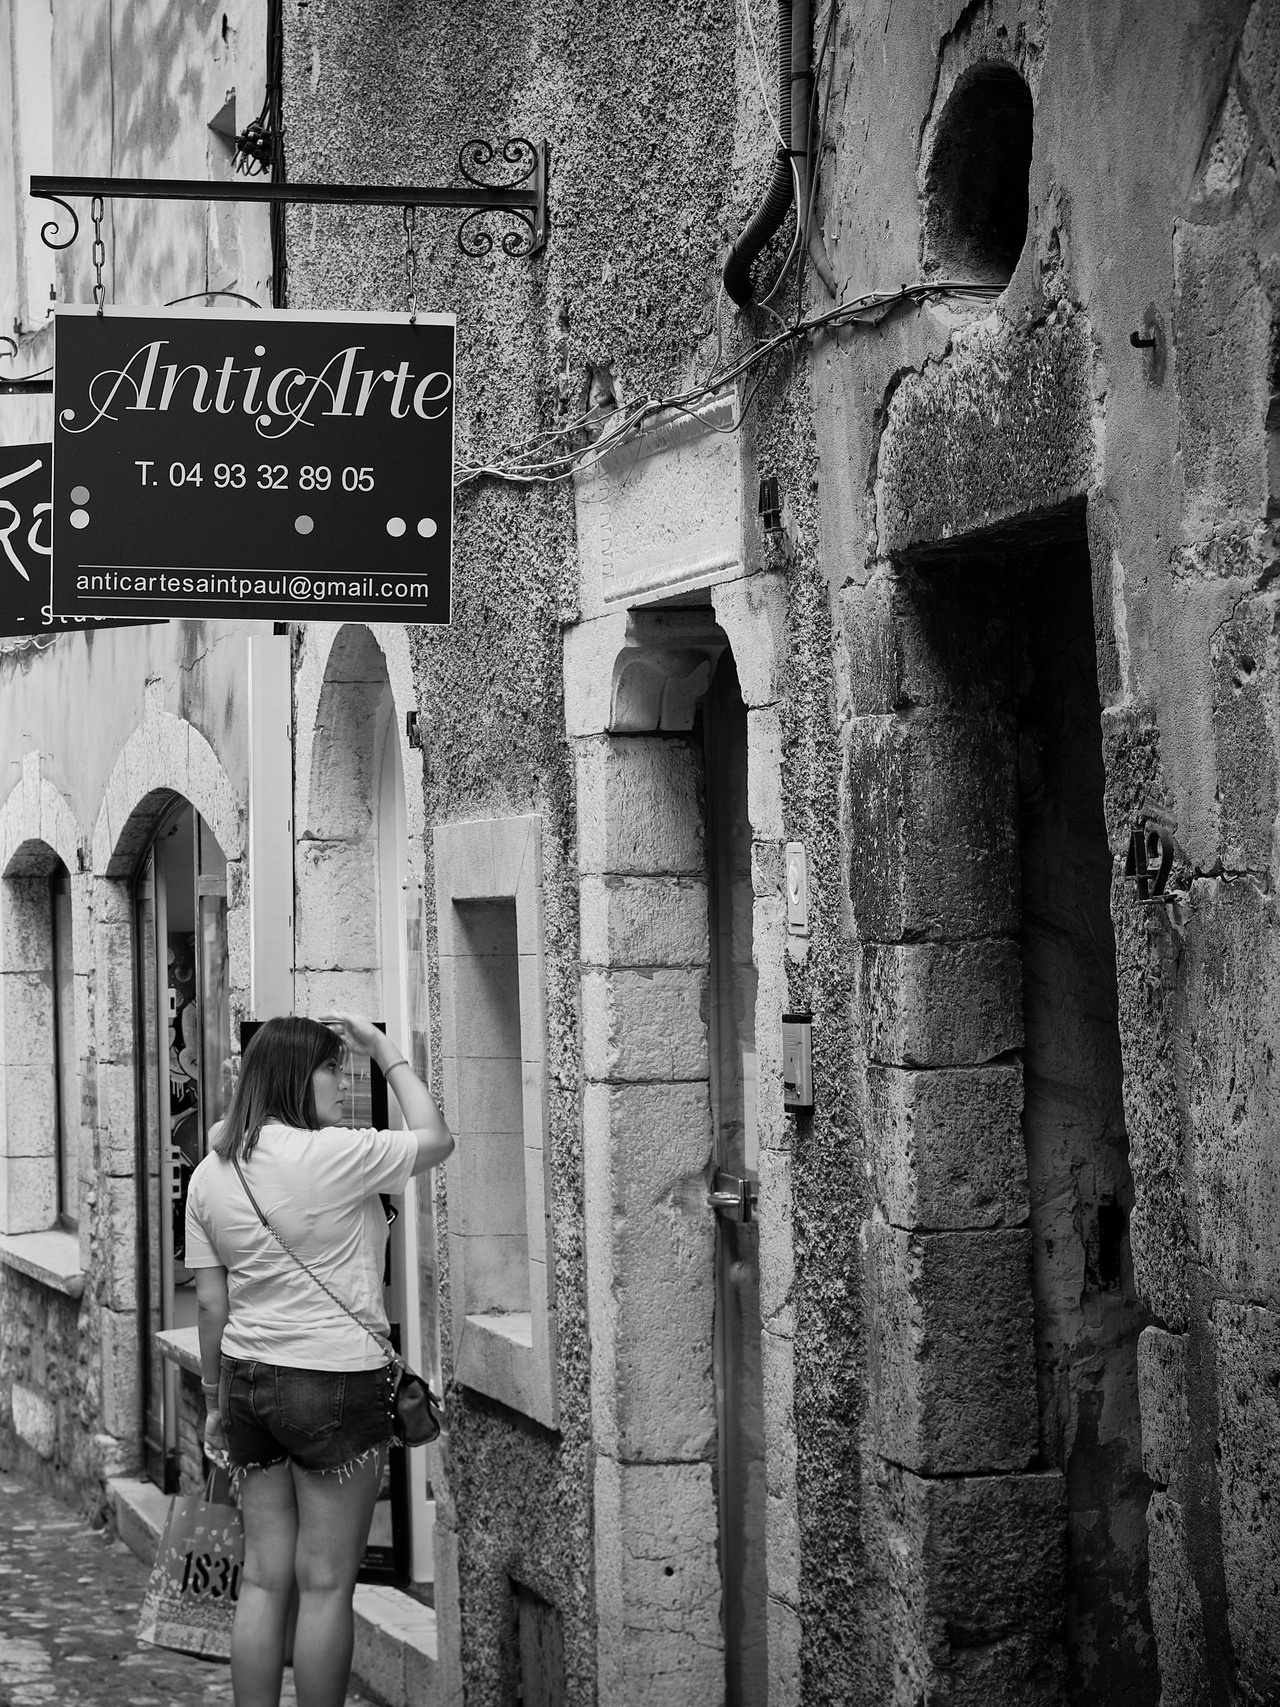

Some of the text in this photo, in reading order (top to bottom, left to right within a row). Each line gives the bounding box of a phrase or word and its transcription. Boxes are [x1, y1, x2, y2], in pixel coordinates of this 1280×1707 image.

[58, 340, 451, 439] AnticArte
[134, 460, 375, 492] T. 04 93 32 89 05
[76, 572, 429, 599] anticartesaintpaul@gmail.com
